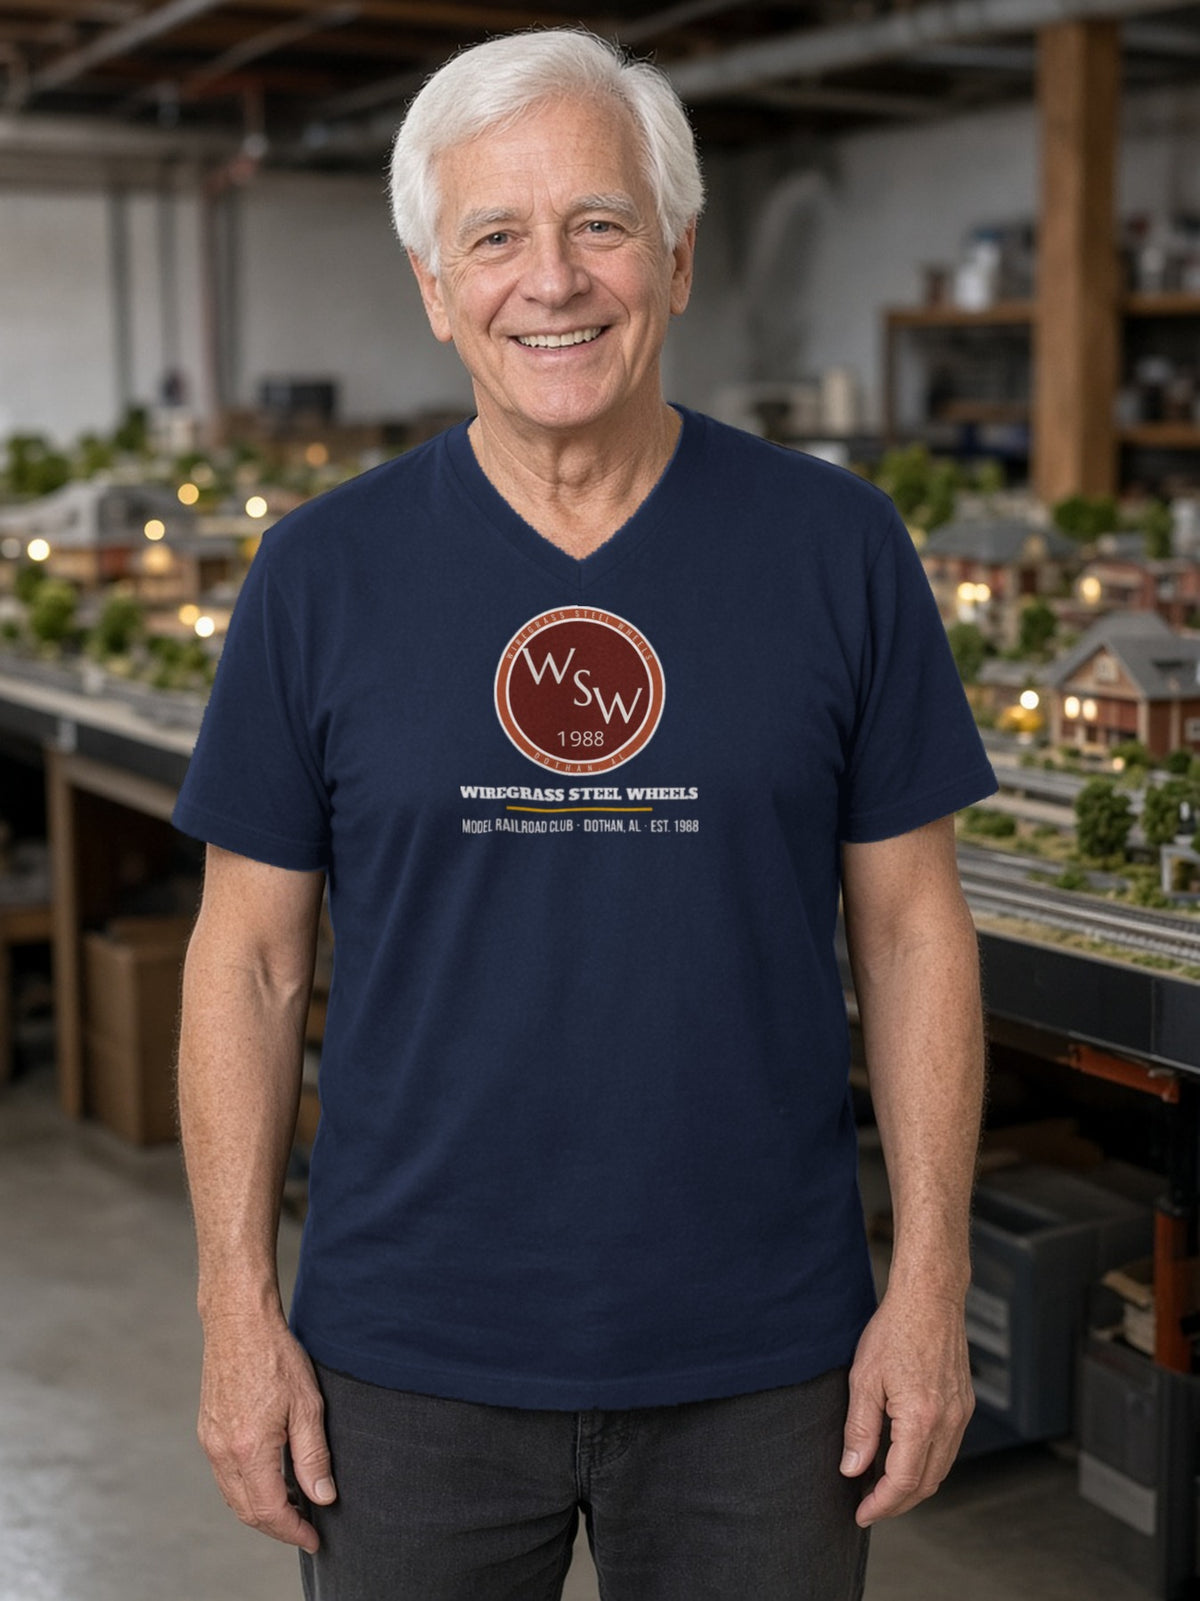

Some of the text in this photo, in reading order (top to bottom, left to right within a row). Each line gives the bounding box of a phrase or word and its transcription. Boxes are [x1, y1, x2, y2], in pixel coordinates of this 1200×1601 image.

[506, 609, 653, 660] WIREGRASS STEEL WHEELS
[557, 730, 604, 747] 1988
[460, 785, 699, 802] WIREGRASS STEEL WHEELS
[462, 818, 700, 834] MODEL RAILROAD CLUB DOTHAN, AL EST. 1988
